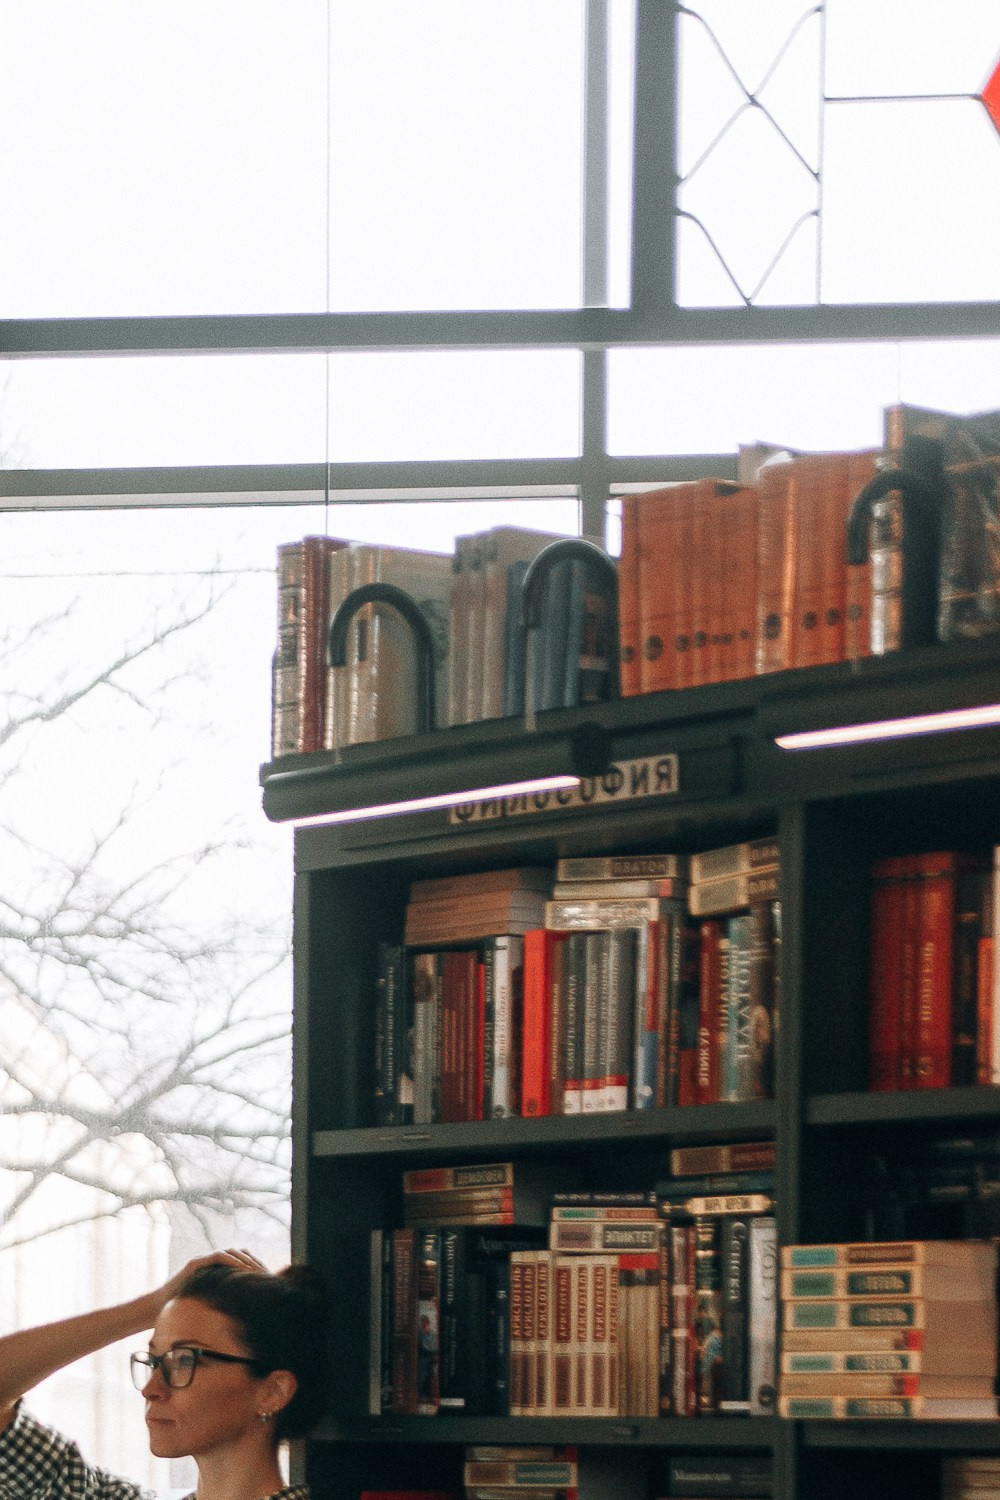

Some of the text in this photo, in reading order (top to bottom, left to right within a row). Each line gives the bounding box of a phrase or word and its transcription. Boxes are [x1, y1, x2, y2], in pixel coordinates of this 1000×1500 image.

[566, 974, 578, 1071] СМЕРТЬ СОКРАТА
[698, 1026, 711, 1087] ЭПИКУР
[604, 1229, 655, 1244] ЭПИКТЕТ
[729, 1220, 747, 1302] Сенека
[512, 1266, 522, 1338] АРИСТОТЕЛЬ
[523, 1266, 534, 1338] АРИСТОТЕЛЬ
[538, 1266, 548, 1337] АРИСТОТЕЛЬ
[558, 1270, 569, 1338] АРИСТОТЕЛЬ
[577, 1268, 588, 1340] АРИСТОТЕЛЬ
[594, 1267, 605, 1339] АРИСТОТЕЛЬ
